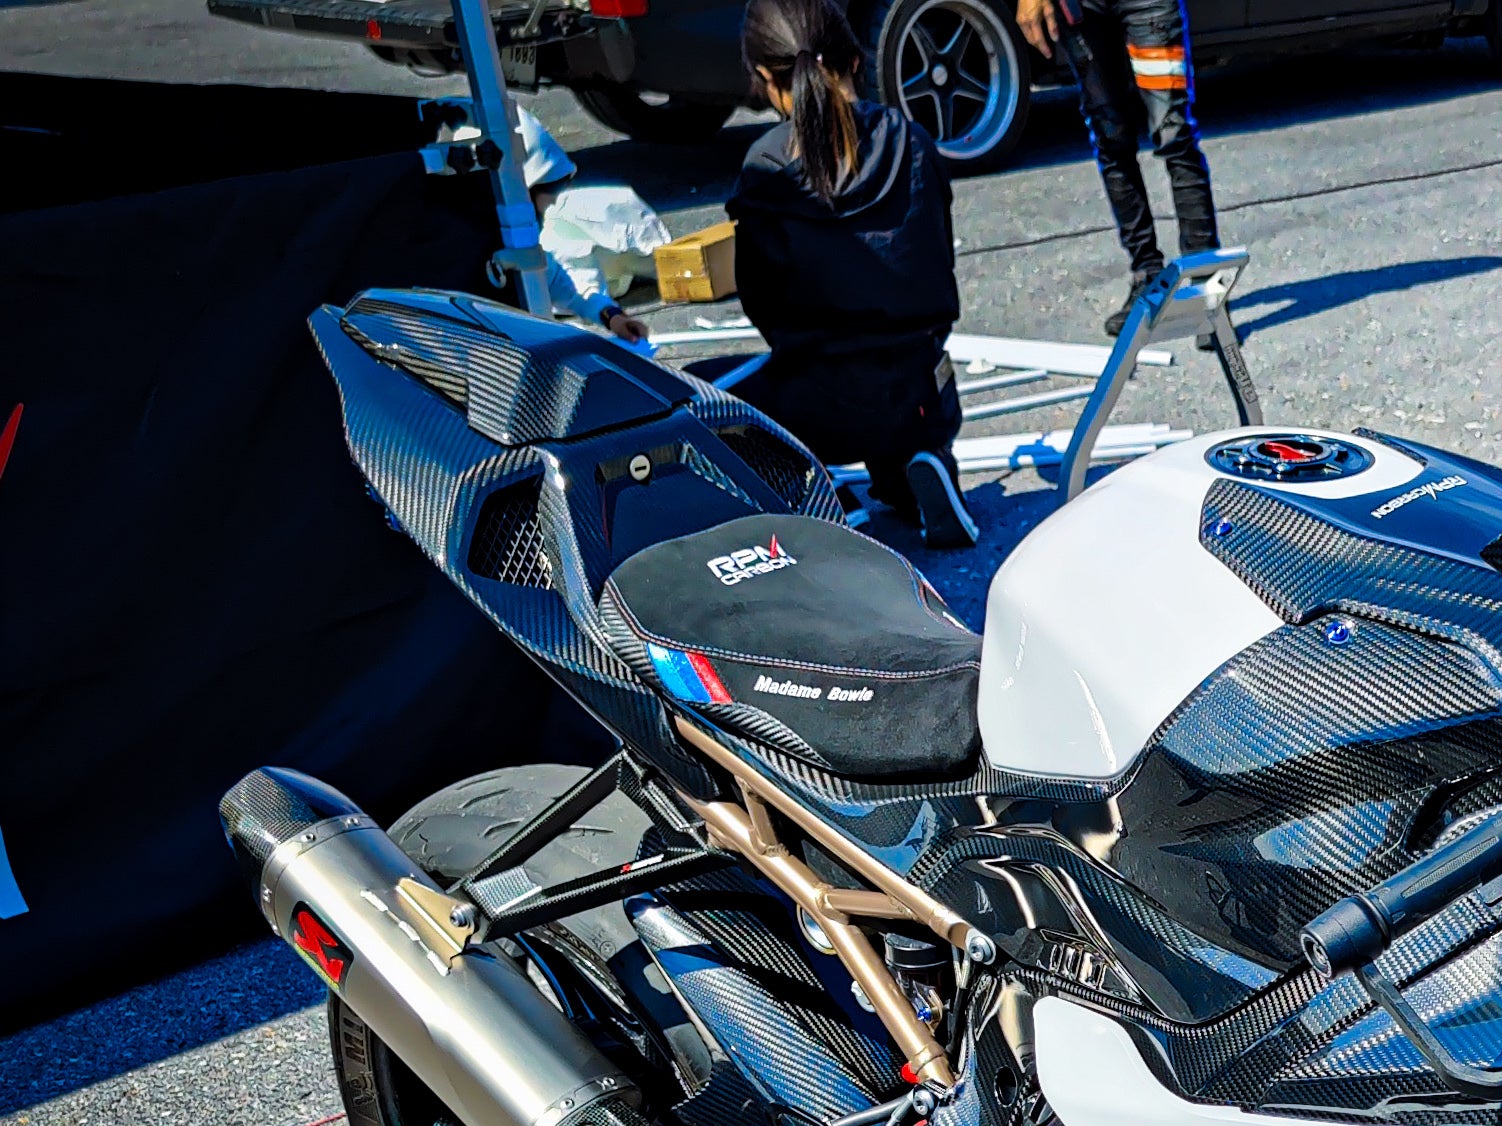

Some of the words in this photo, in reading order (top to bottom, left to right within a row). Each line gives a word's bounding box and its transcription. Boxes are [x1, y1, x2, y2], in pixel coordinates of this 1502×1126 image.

[707, 533, 786, 578] RPM
[720, 555, 797, 587] CARBON
[754, 674, 822, 699] Madame
